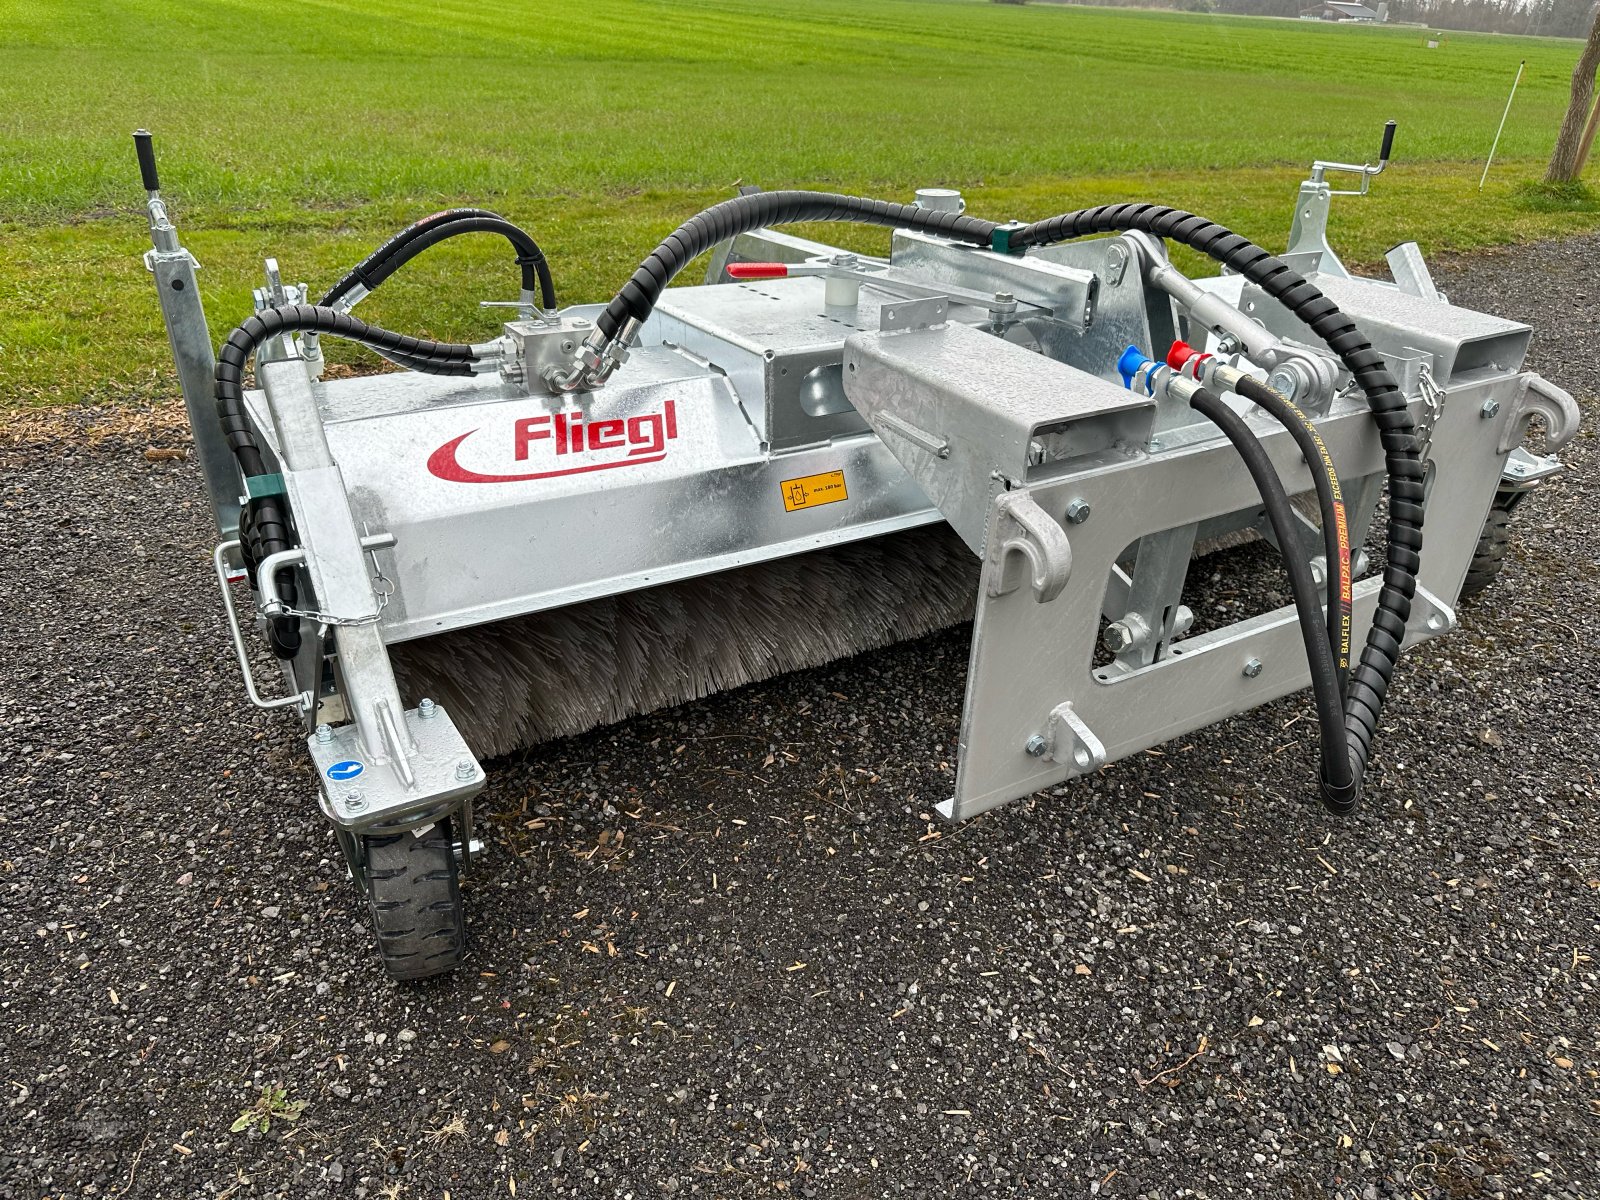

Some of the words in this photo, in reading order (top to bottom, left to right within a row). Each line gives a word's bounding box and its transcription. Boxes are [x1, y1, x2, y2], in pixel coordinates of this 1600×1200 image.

[515, 400, 678, 461] Fliegl
[1319, 445, 1329, 455] EN
[1322, 455, 1333, 467] DIN
[1327, 467, 1342, 500] EXCEEDS
[1335, 503, 1349, 550] PREMIUM
[1342, 557, 1351, 600] BALPAC
[1341, 615, 1350, 654] BALFLEX
